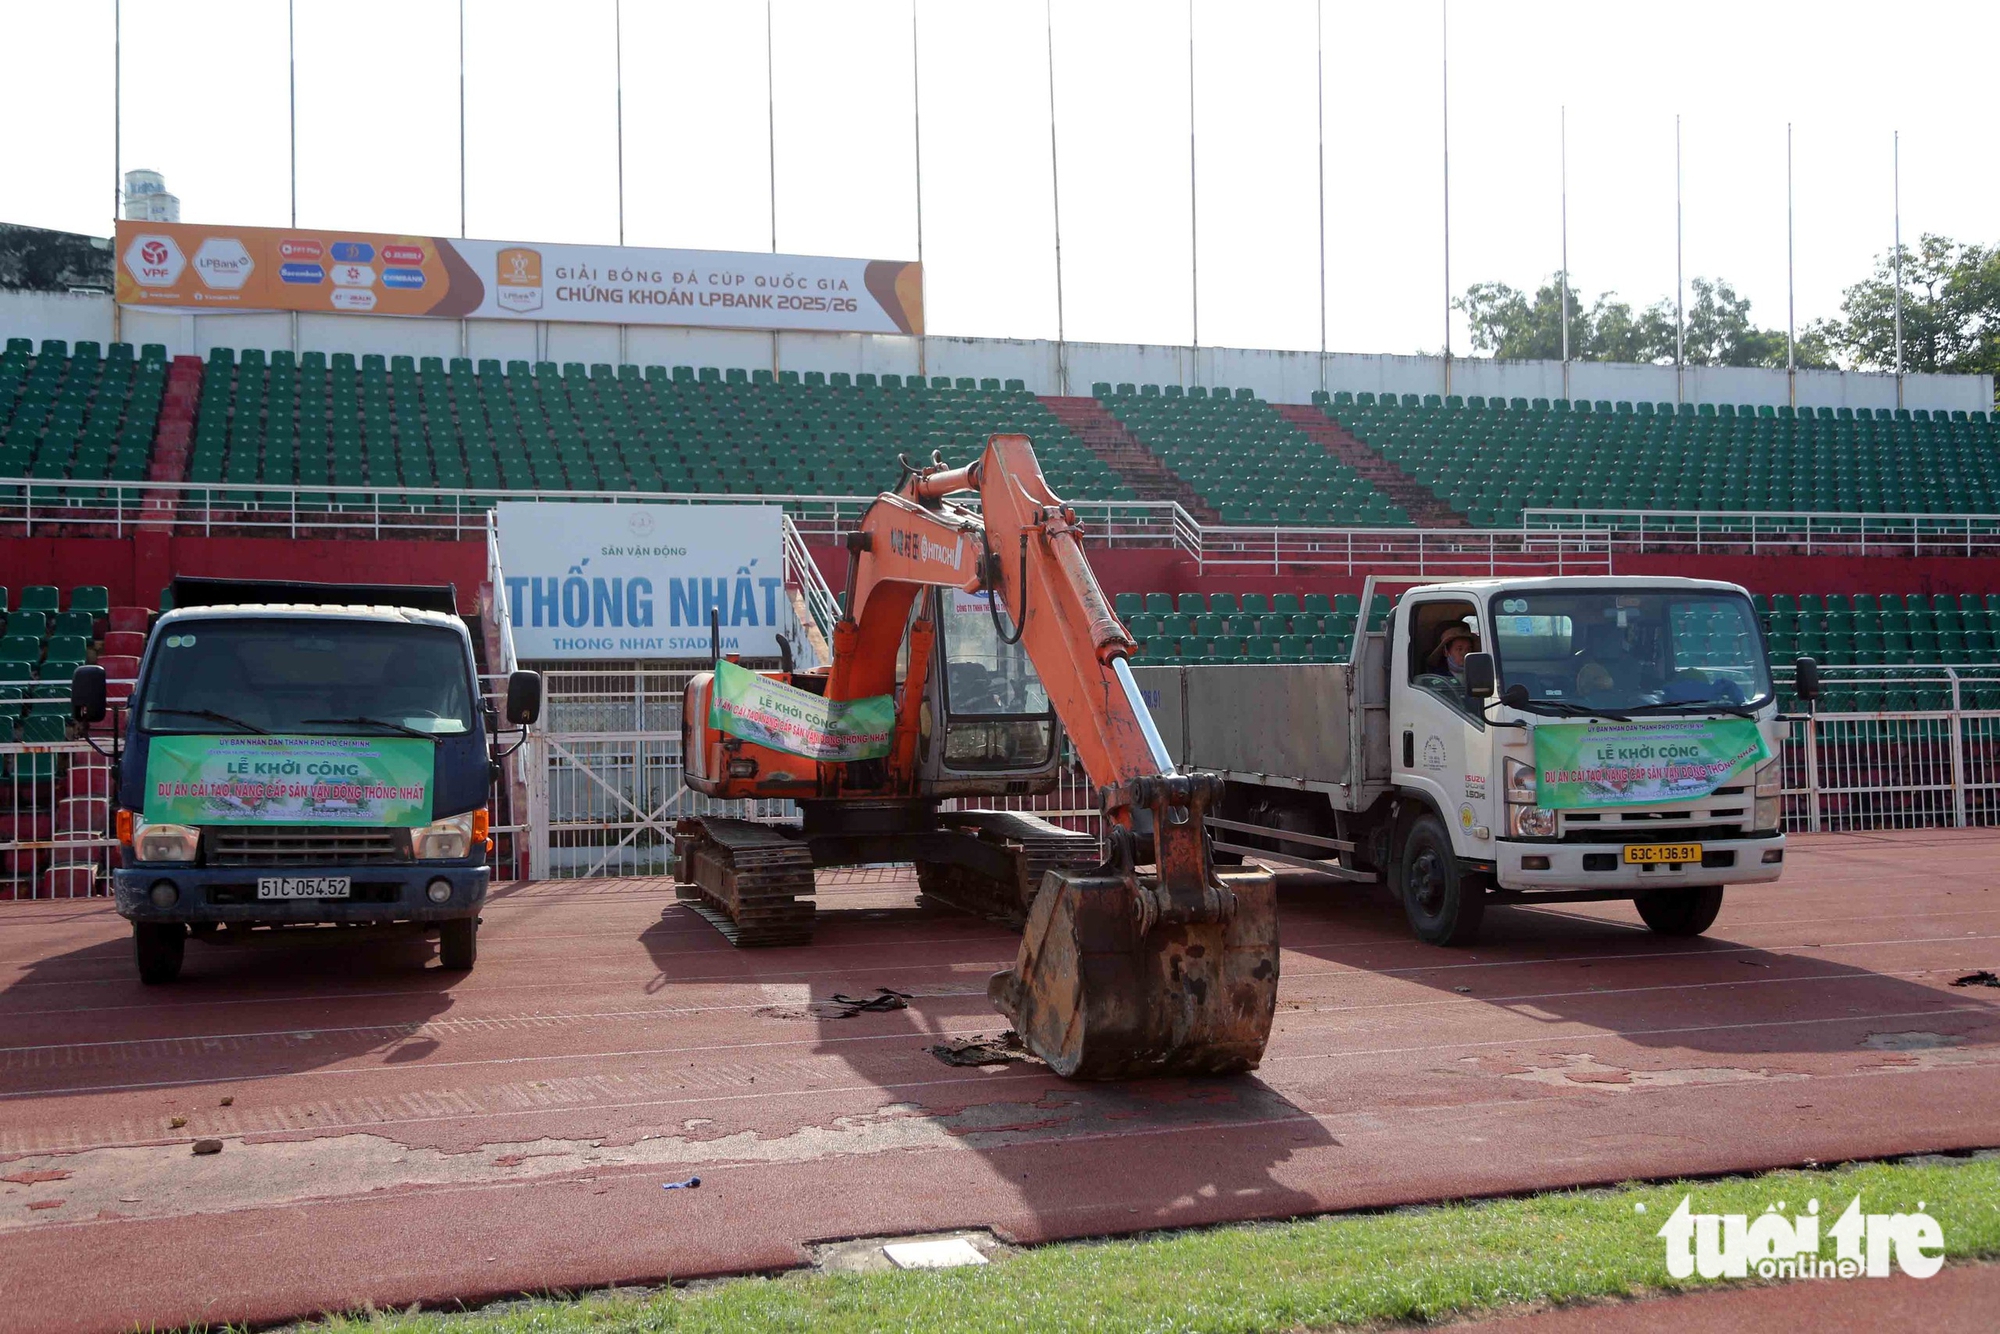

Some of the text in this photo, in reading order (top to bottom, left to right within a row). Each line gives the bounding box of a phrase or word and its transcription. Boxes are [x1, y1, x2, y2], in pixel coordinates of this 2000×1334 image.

[200, 258, 239, 269] LPBank
[143, 268, 169, 278] VPF
[281, 268, 323, 278] Sacombank
[555, 263, 597, 281] GIẢI
[608, 266, 663, 283] BÓNG
[672, 269, 699, 285] ĐÁ
[754, 271, 808, 289] QUỐC
[817, 278, 850, 291] GIA
[555, 284, 858, 312] CHỨNG KHOÁN LPBANK 2025/26
[626, 545, 651, 559] VẬN
[653, 545, 687, 559] ĐỘNG
[928, 541, 956, 567] HITACHI
[504, 558, 782, 628] THỐNG NHẤT
[552, 637, 614, 650] THONG
[620, 637, 664, 650] NHAT
[759, 694, 772, 709] LỄ
[775, 702, 803, 719] KHỞI
[805, 713, 838, 730] CÔNG
[1597, 725, 1608, 733] BAN
[230, 739, 246, 747] BAN
[352, 739, 370, 748] MINH
[1597, 744, 1699, 760] LỄ KHỞI CÔNG
[227, 757, 359, 776] LỄ KHỞI CÔNG
[1545, 770, 1557, 787] DỰ
[1571, 766, 1585, 782] CẢI
[1605, 766, 1628, 782] NÂNG
[1629, 763, 1646, 782] CẤP
[1648, 764, 1662, 780] SÂN
[1707, 759, 1737, 776] THỐNG
[1737, 744, 1758, 760] NHẤT
[1465, 774, 1485, 783] ISUZU
[158, 783, 171, 800] DỰ
[174, 779, 188, 797] ÁN
[190, 779, 209, 797] CẢI
[235, 780, 265, 798] NÂNG
[265, 779, 287, 798] CẤP
[288, 781, 308, 799] SÂN
[310, 782, 331, 802] VẬN
[333, 782, 362, 802] ĐỘNG
[364, 780, 398, 800] THỐNG
[399, 782, 425, 800] NHẤT
[1631, 847, 1695, 860] 63C-136.91
[261, 879, 347, 897] 51C-054.52
